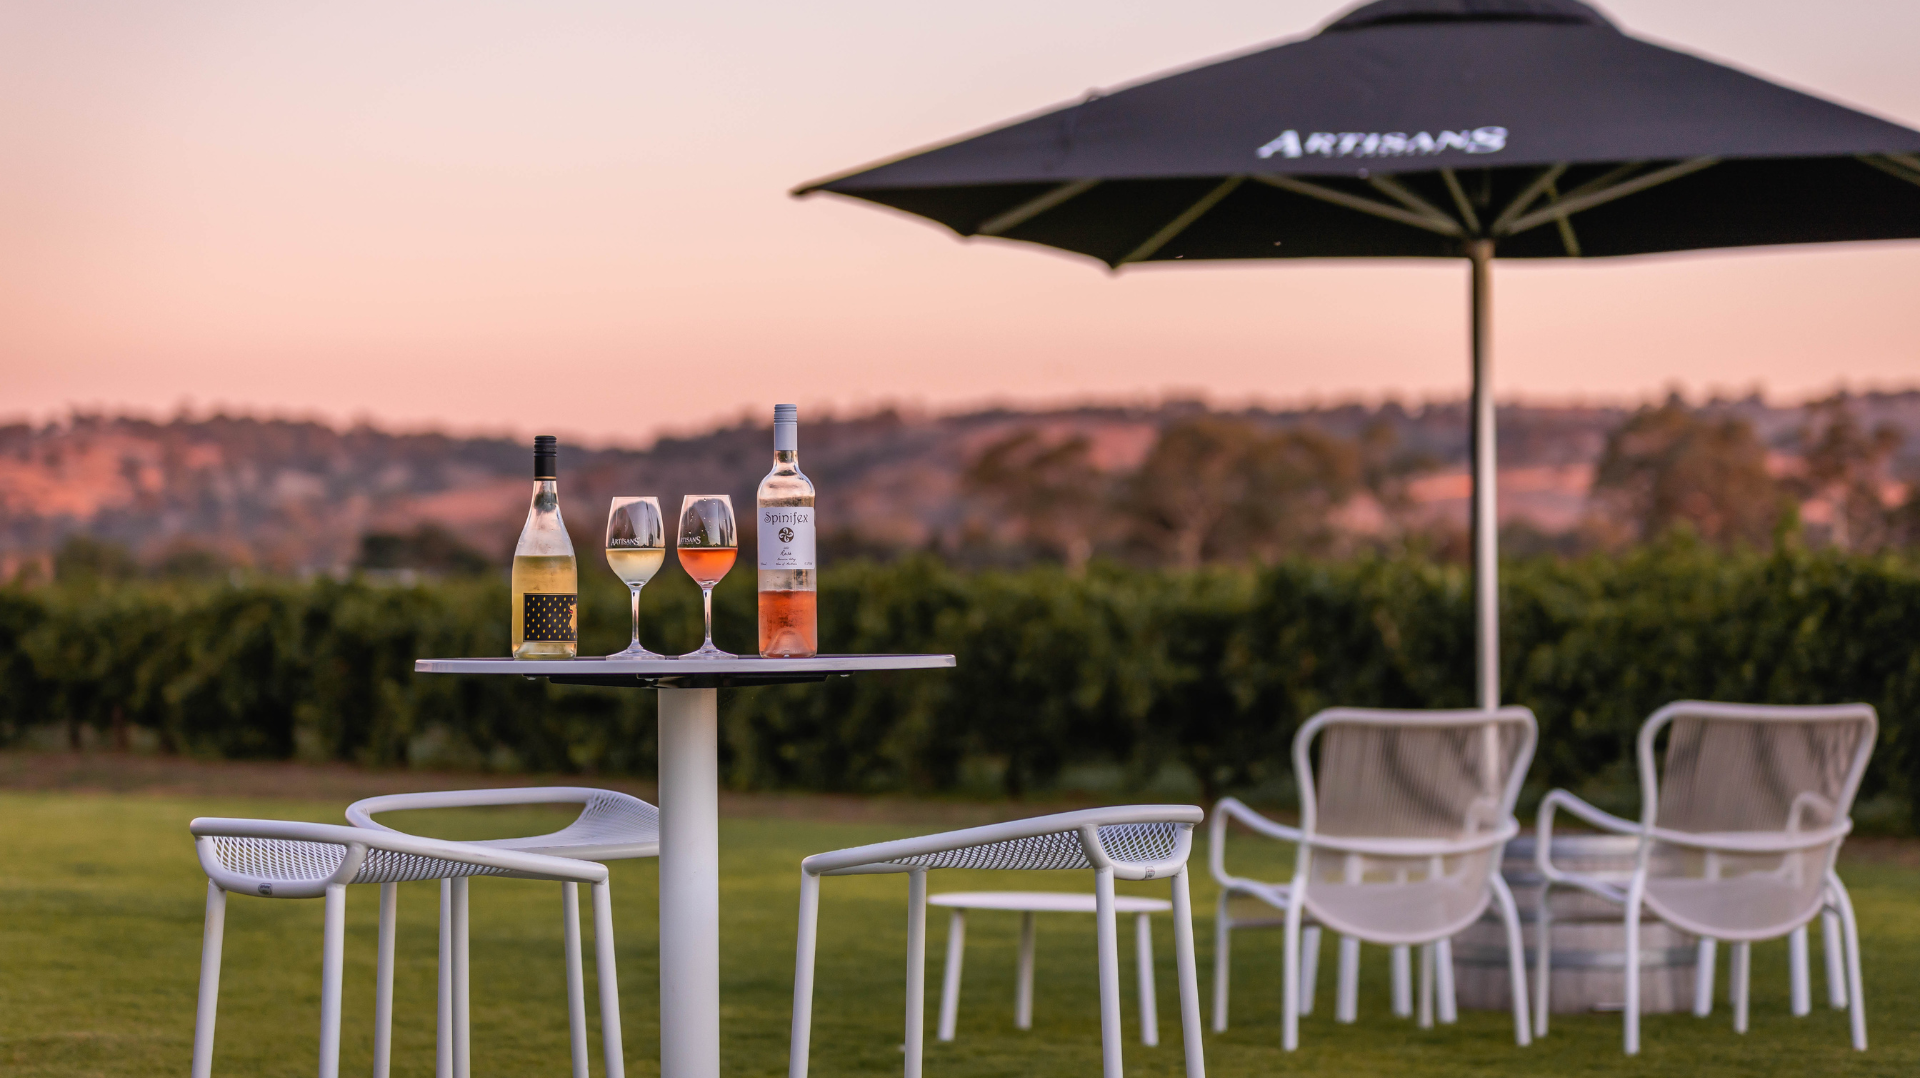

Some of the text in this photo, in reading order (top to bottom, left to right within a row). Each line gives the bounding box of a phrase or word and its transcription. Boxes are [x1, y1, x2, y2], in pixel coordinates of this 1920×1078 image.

[1256, 125, 1509, 159] ARTISANS
[764, 511, 809, 526] Spinifex
[610, 537, 640, 546] ARTISANS
